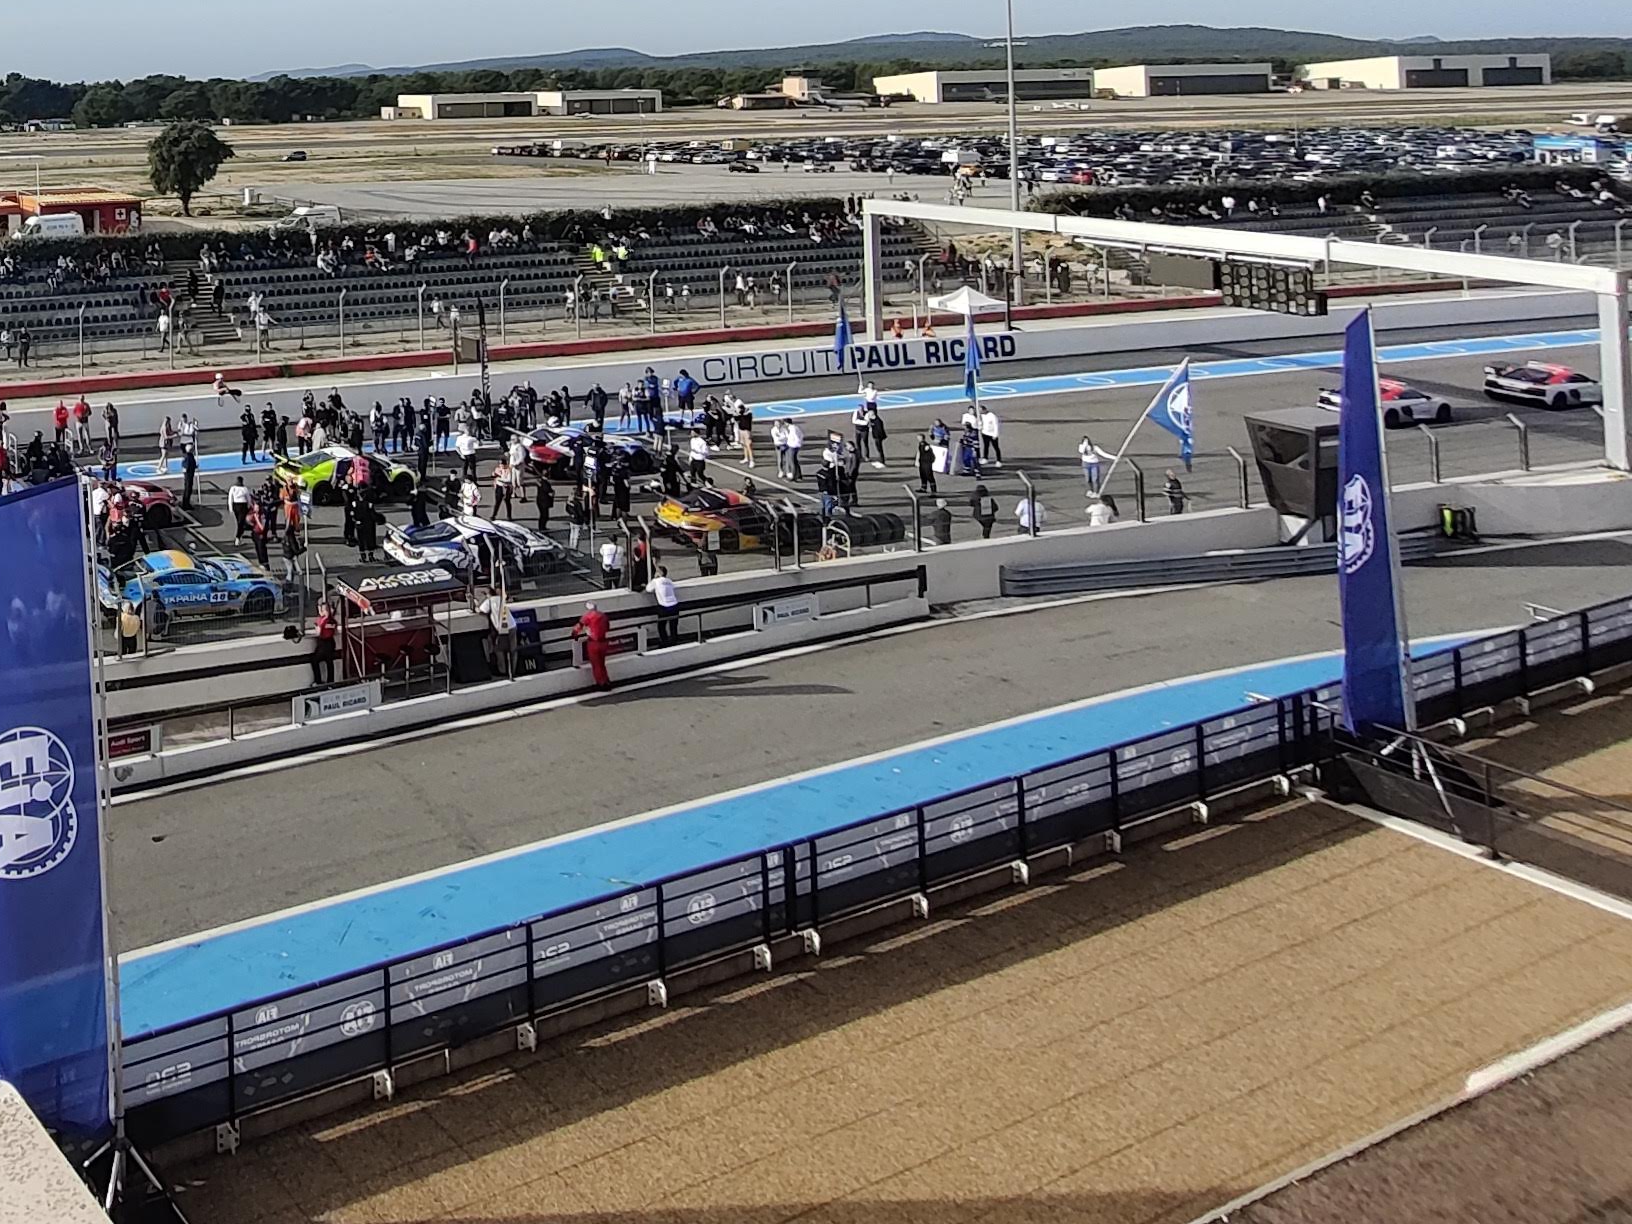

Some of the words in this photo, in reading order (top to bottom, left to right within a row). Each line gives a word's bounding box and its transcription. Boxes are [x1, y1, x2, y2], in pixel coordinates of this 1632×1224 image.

[703, 349, 838, 382] CIRCUIT
[850, 342, 915, 369] PAUL
[358, 568, 453, 592] AKKODIS
